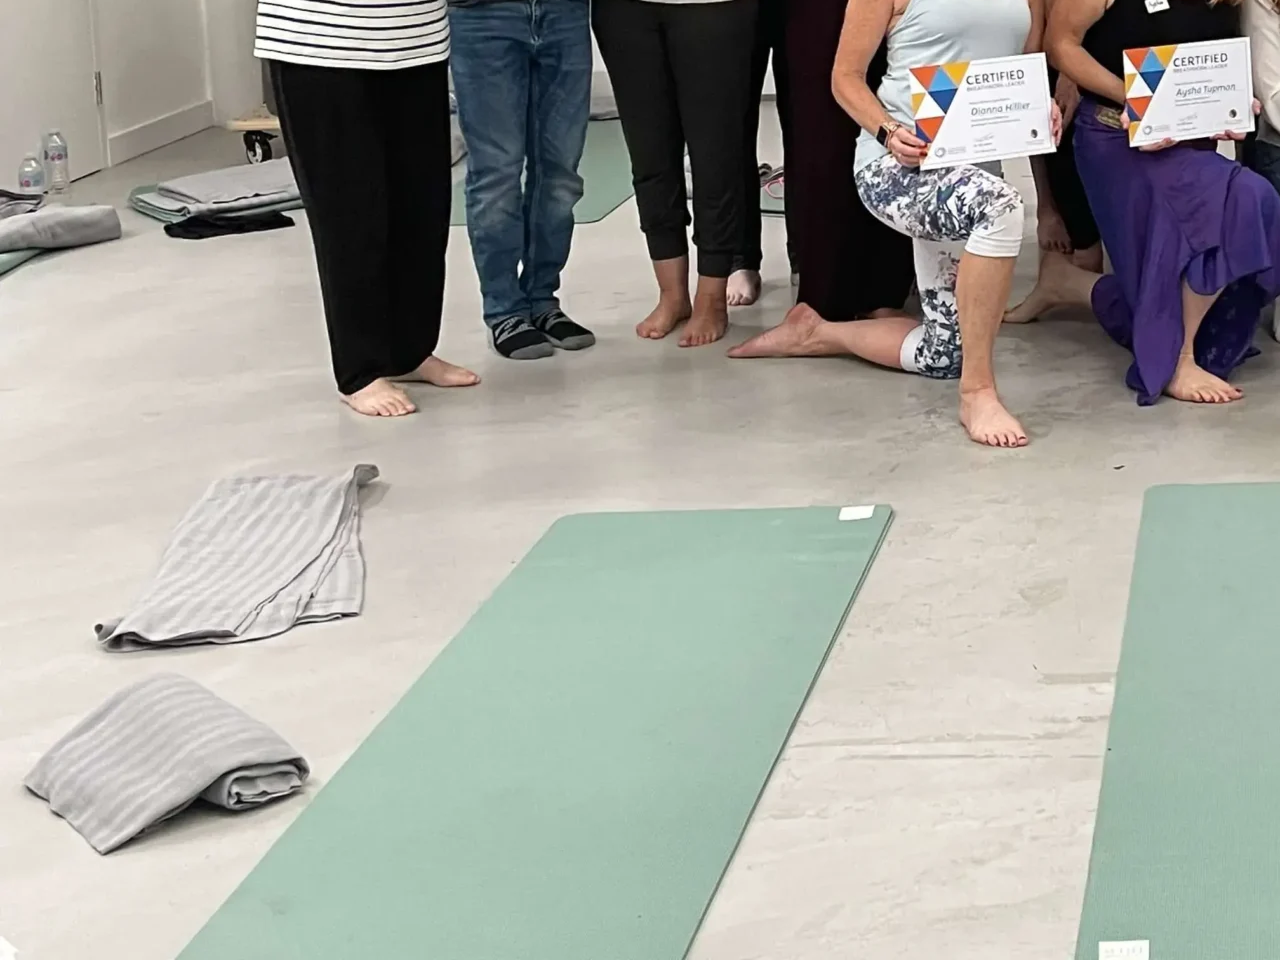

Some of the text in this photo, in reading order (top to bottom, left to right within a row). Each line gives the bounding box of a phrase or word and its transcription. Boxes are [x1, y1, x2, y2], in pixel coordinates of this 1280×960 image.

[1173, 52, 1228, 68] CERTIFIED
[966, 69, 1025, 86] CERTIFIED
[1176, 84, 1236, 98] Aysha Tupman
[970, 102, 1031, 117] Dianna Hillier
